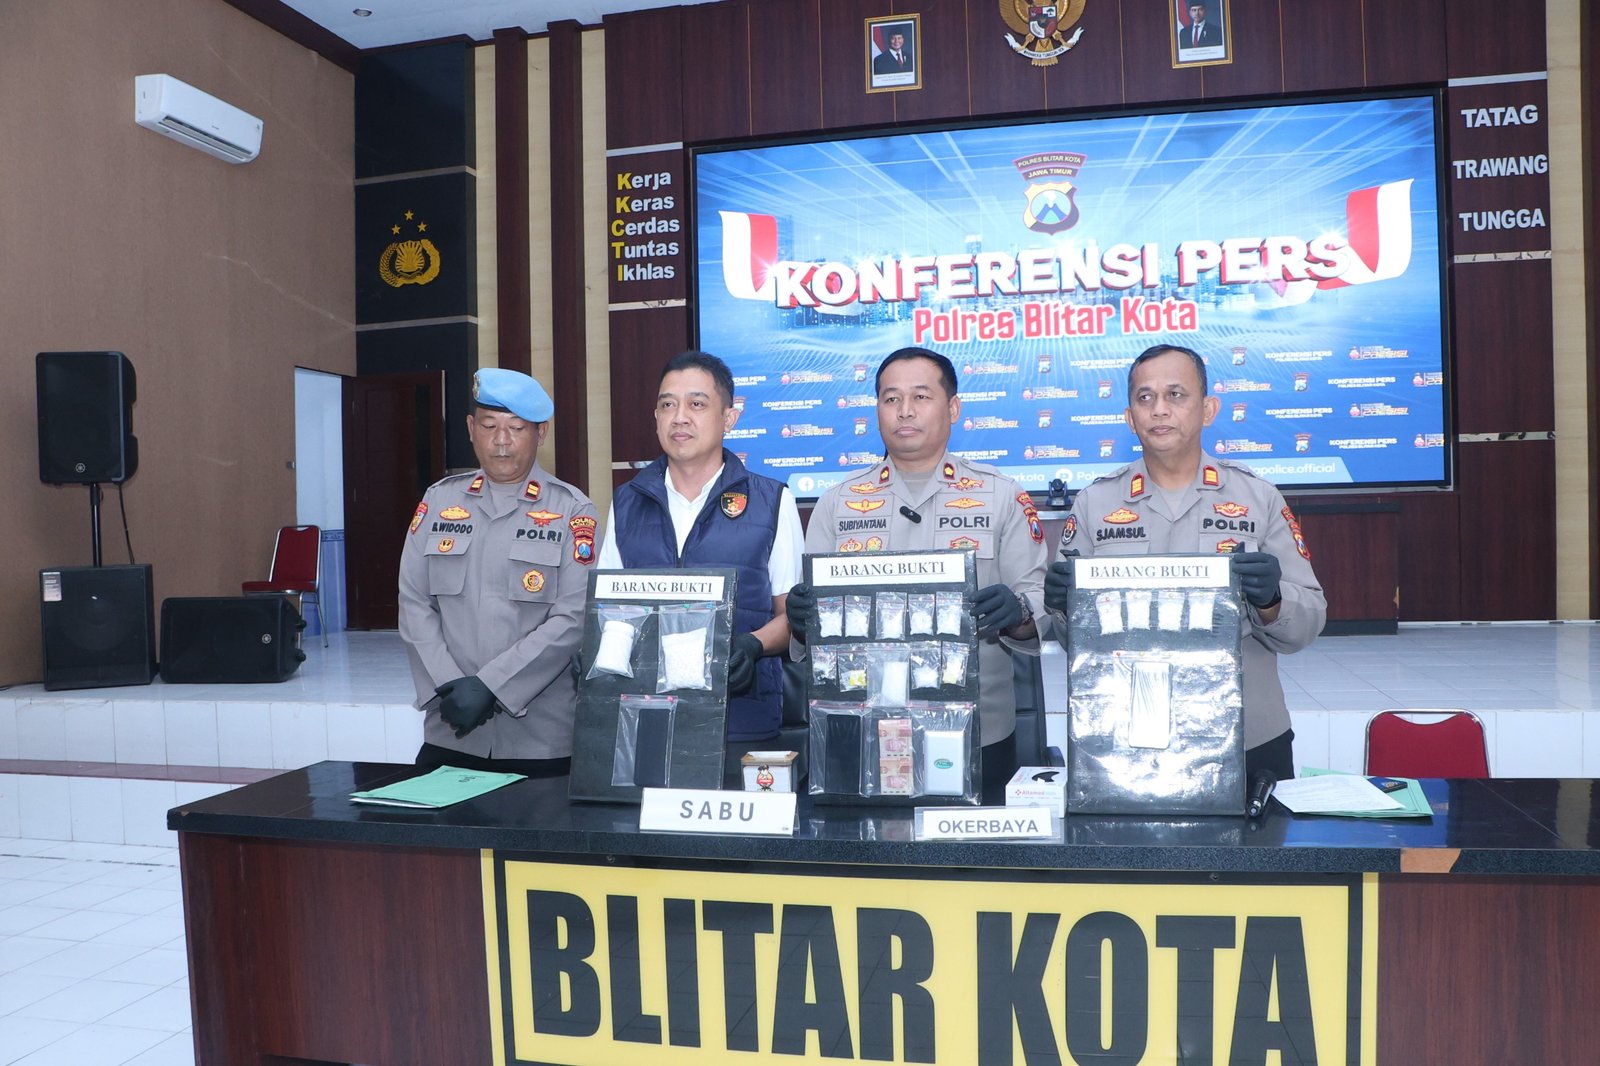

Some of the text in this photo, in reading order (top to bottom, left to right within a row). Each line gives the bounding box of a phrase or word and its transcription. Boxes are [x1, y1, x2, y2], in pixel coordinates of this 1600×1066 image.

[1461, 104, 1538, 128] TATAG
[1018, 155, 1081, 167] POLRES BLITAR KOTA
[1453, 154, 1548, 179] TRAWANG
[617, 171, 672, 190] Kerja
[1028, 168, 1073, 178] JAWA TIMUR
[616, 196, 675, 213] Keras
[611, 217, 680, 236] Cerdas
[1459, 208, 1546, 231] TUNGGA
[611, 240, 680, 259] Tuntas
[617, 263, 675, 281] Ikhlas
[774, 235, 1350, 309] KONFERENSI PERS
[914, 298, 1197, 344] Polres Blitar Kota
[839, 518, 887, 532] SUBIYANTANA
[939, 516, 990, 528] POLRI
[1203, 518, 1255, 533] POLRI
[516, 528, 563, 542] POLRI
[1096, 527, 1147, 541] SJAMSUL
[830, 561, 945, 576] BARANG BUKTI
[1090, 565, 1209, 578] BARANG BUKTI
[611, 581, 713, 593] BARANG BUKTI
[680, 799, 755, 822] SABU
[938, 819, 1039, 834] OKERBAYA
[527, 889, 1319, 1066] BLITAR KOTA
